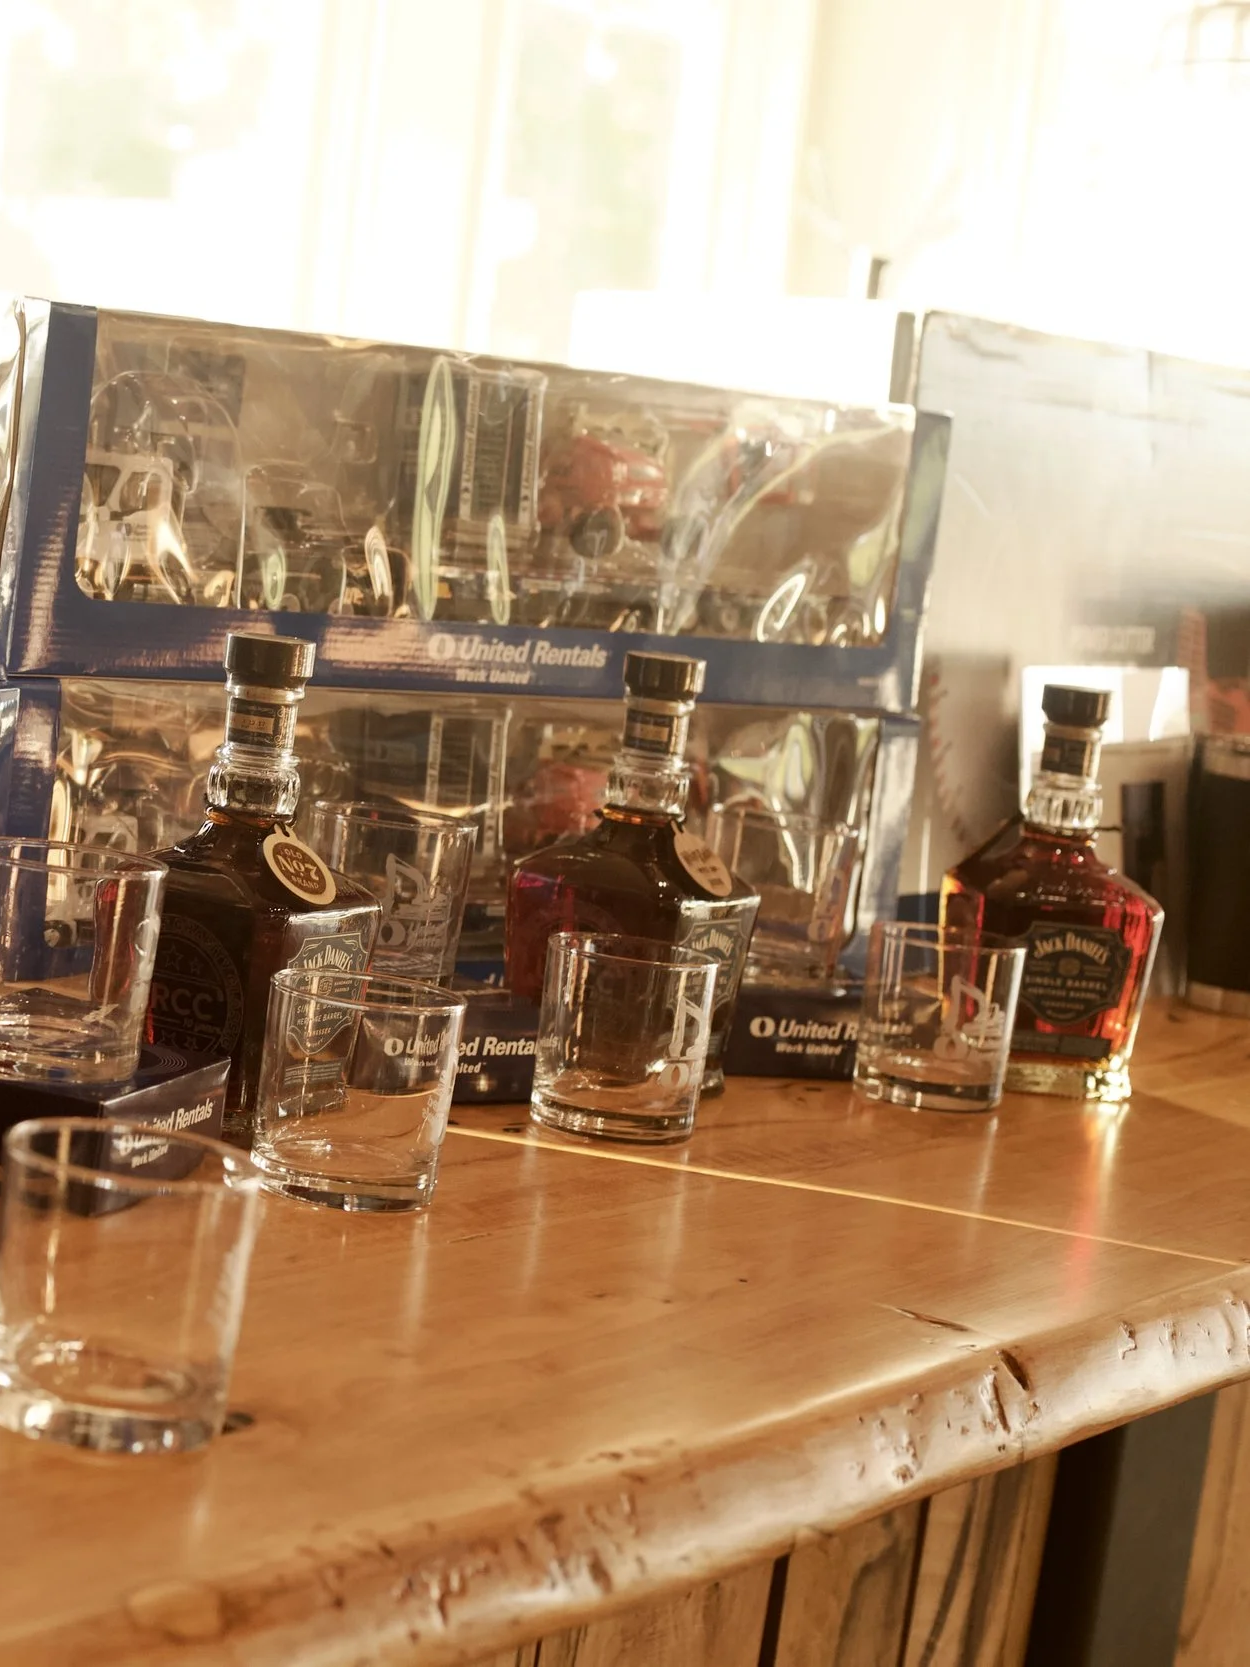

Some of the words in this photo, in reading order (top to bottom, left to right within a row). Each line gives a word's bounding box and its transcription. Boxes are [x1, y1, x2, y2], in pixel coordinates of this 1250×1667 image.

[458, 636, 531, 664] United
[532, 639, 608, 668] Rentals
[778, 1018, 843, 1040] United
[175, 1098, 214, 1131] Rentals
